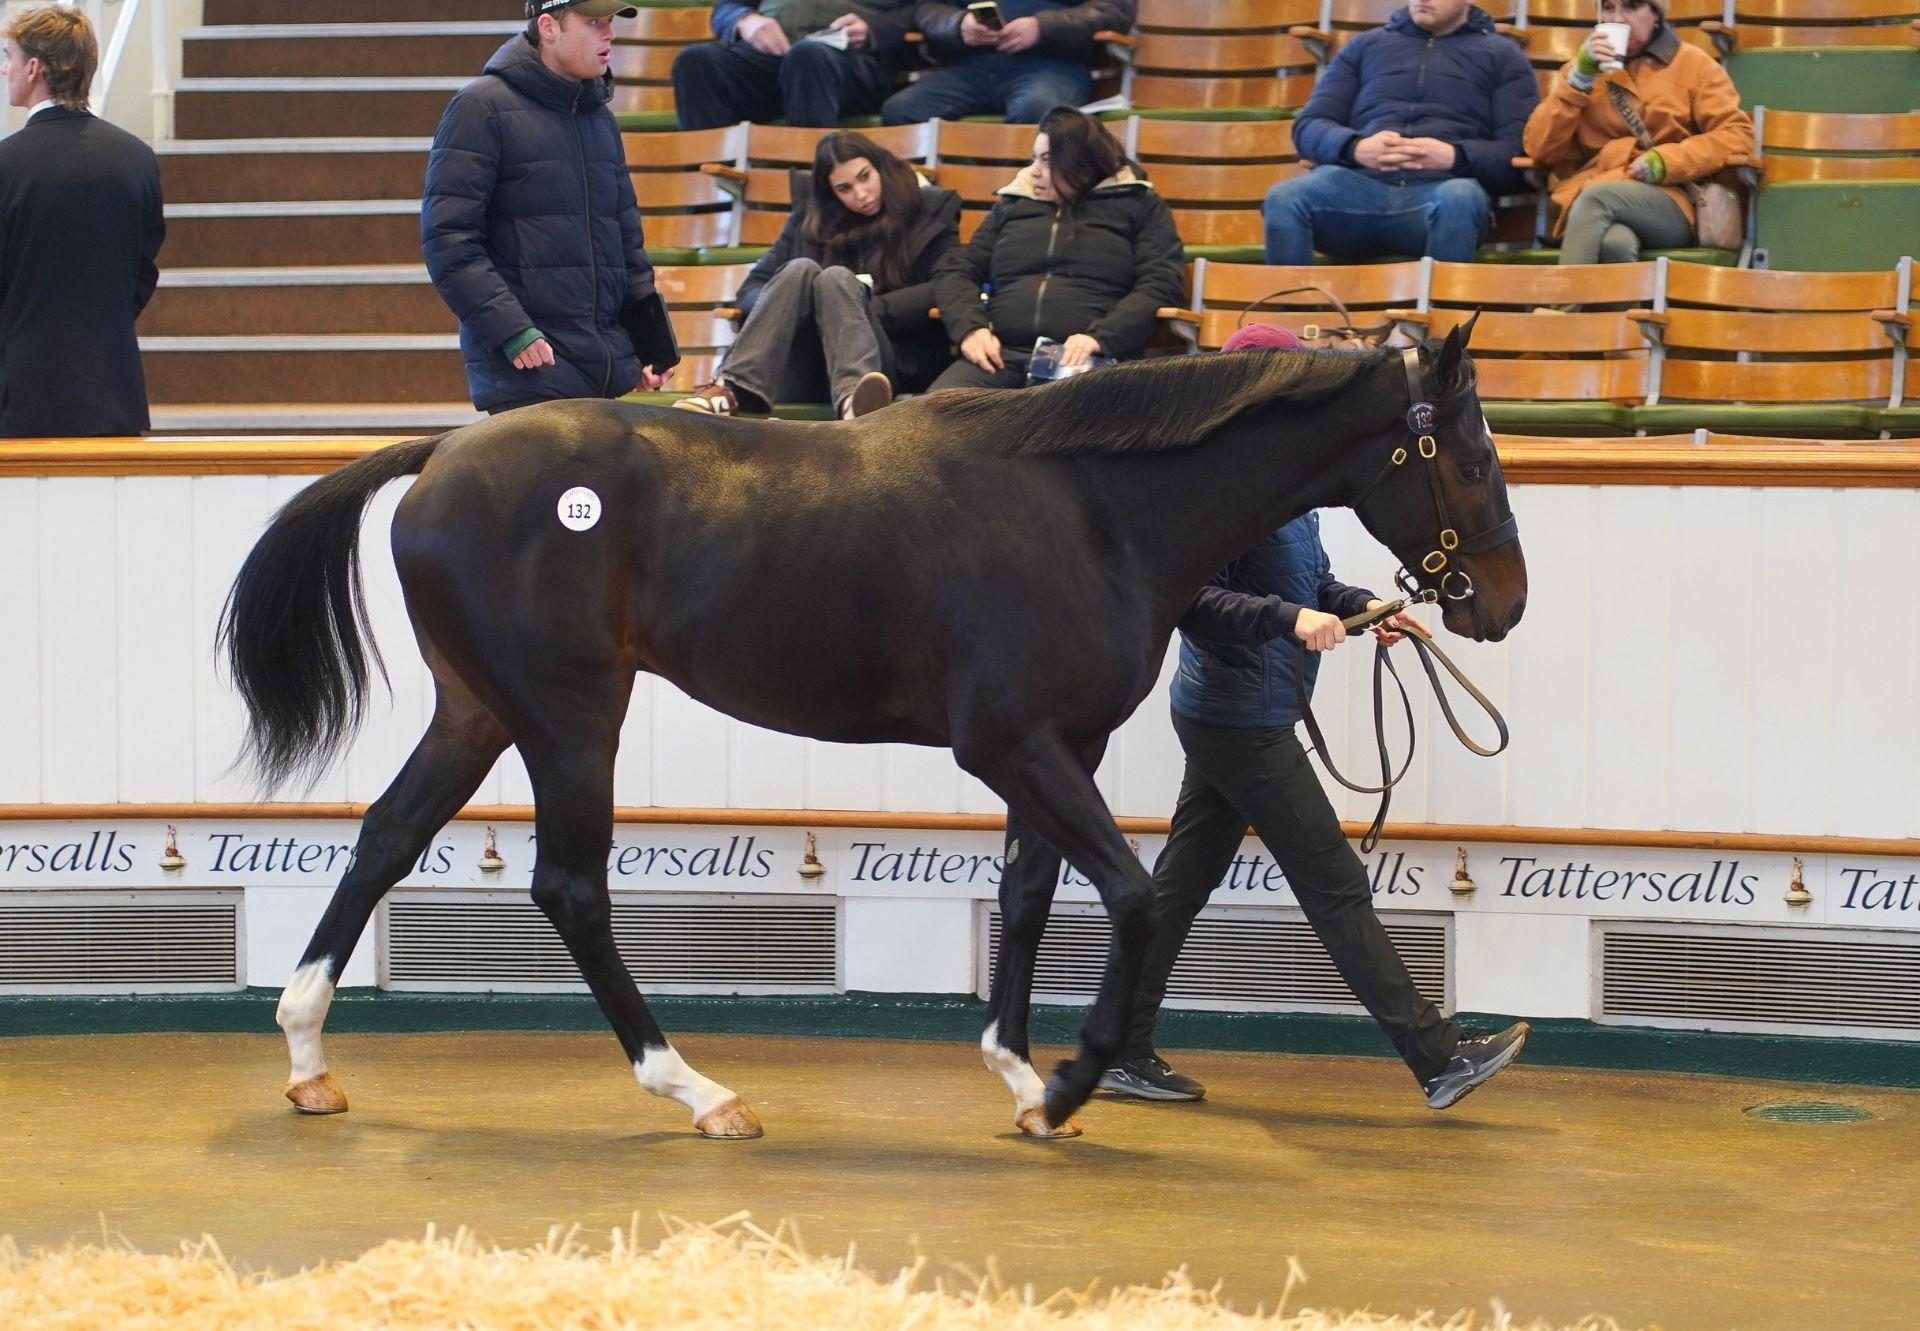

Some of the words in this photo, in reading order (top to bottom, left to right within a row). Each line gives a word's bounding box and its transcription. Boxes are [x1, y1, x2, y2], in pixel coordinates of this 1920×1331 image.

[1415, 411, 1433, 428] 132
[568, 503, 591, 519] 132
[0, 830, 136, 872] rsalls
[208, 833, 455, 874] Tatterls
[1499, 856, 1759, 905] Tattersalls
[1840, 868, 1920, 911] Tat
